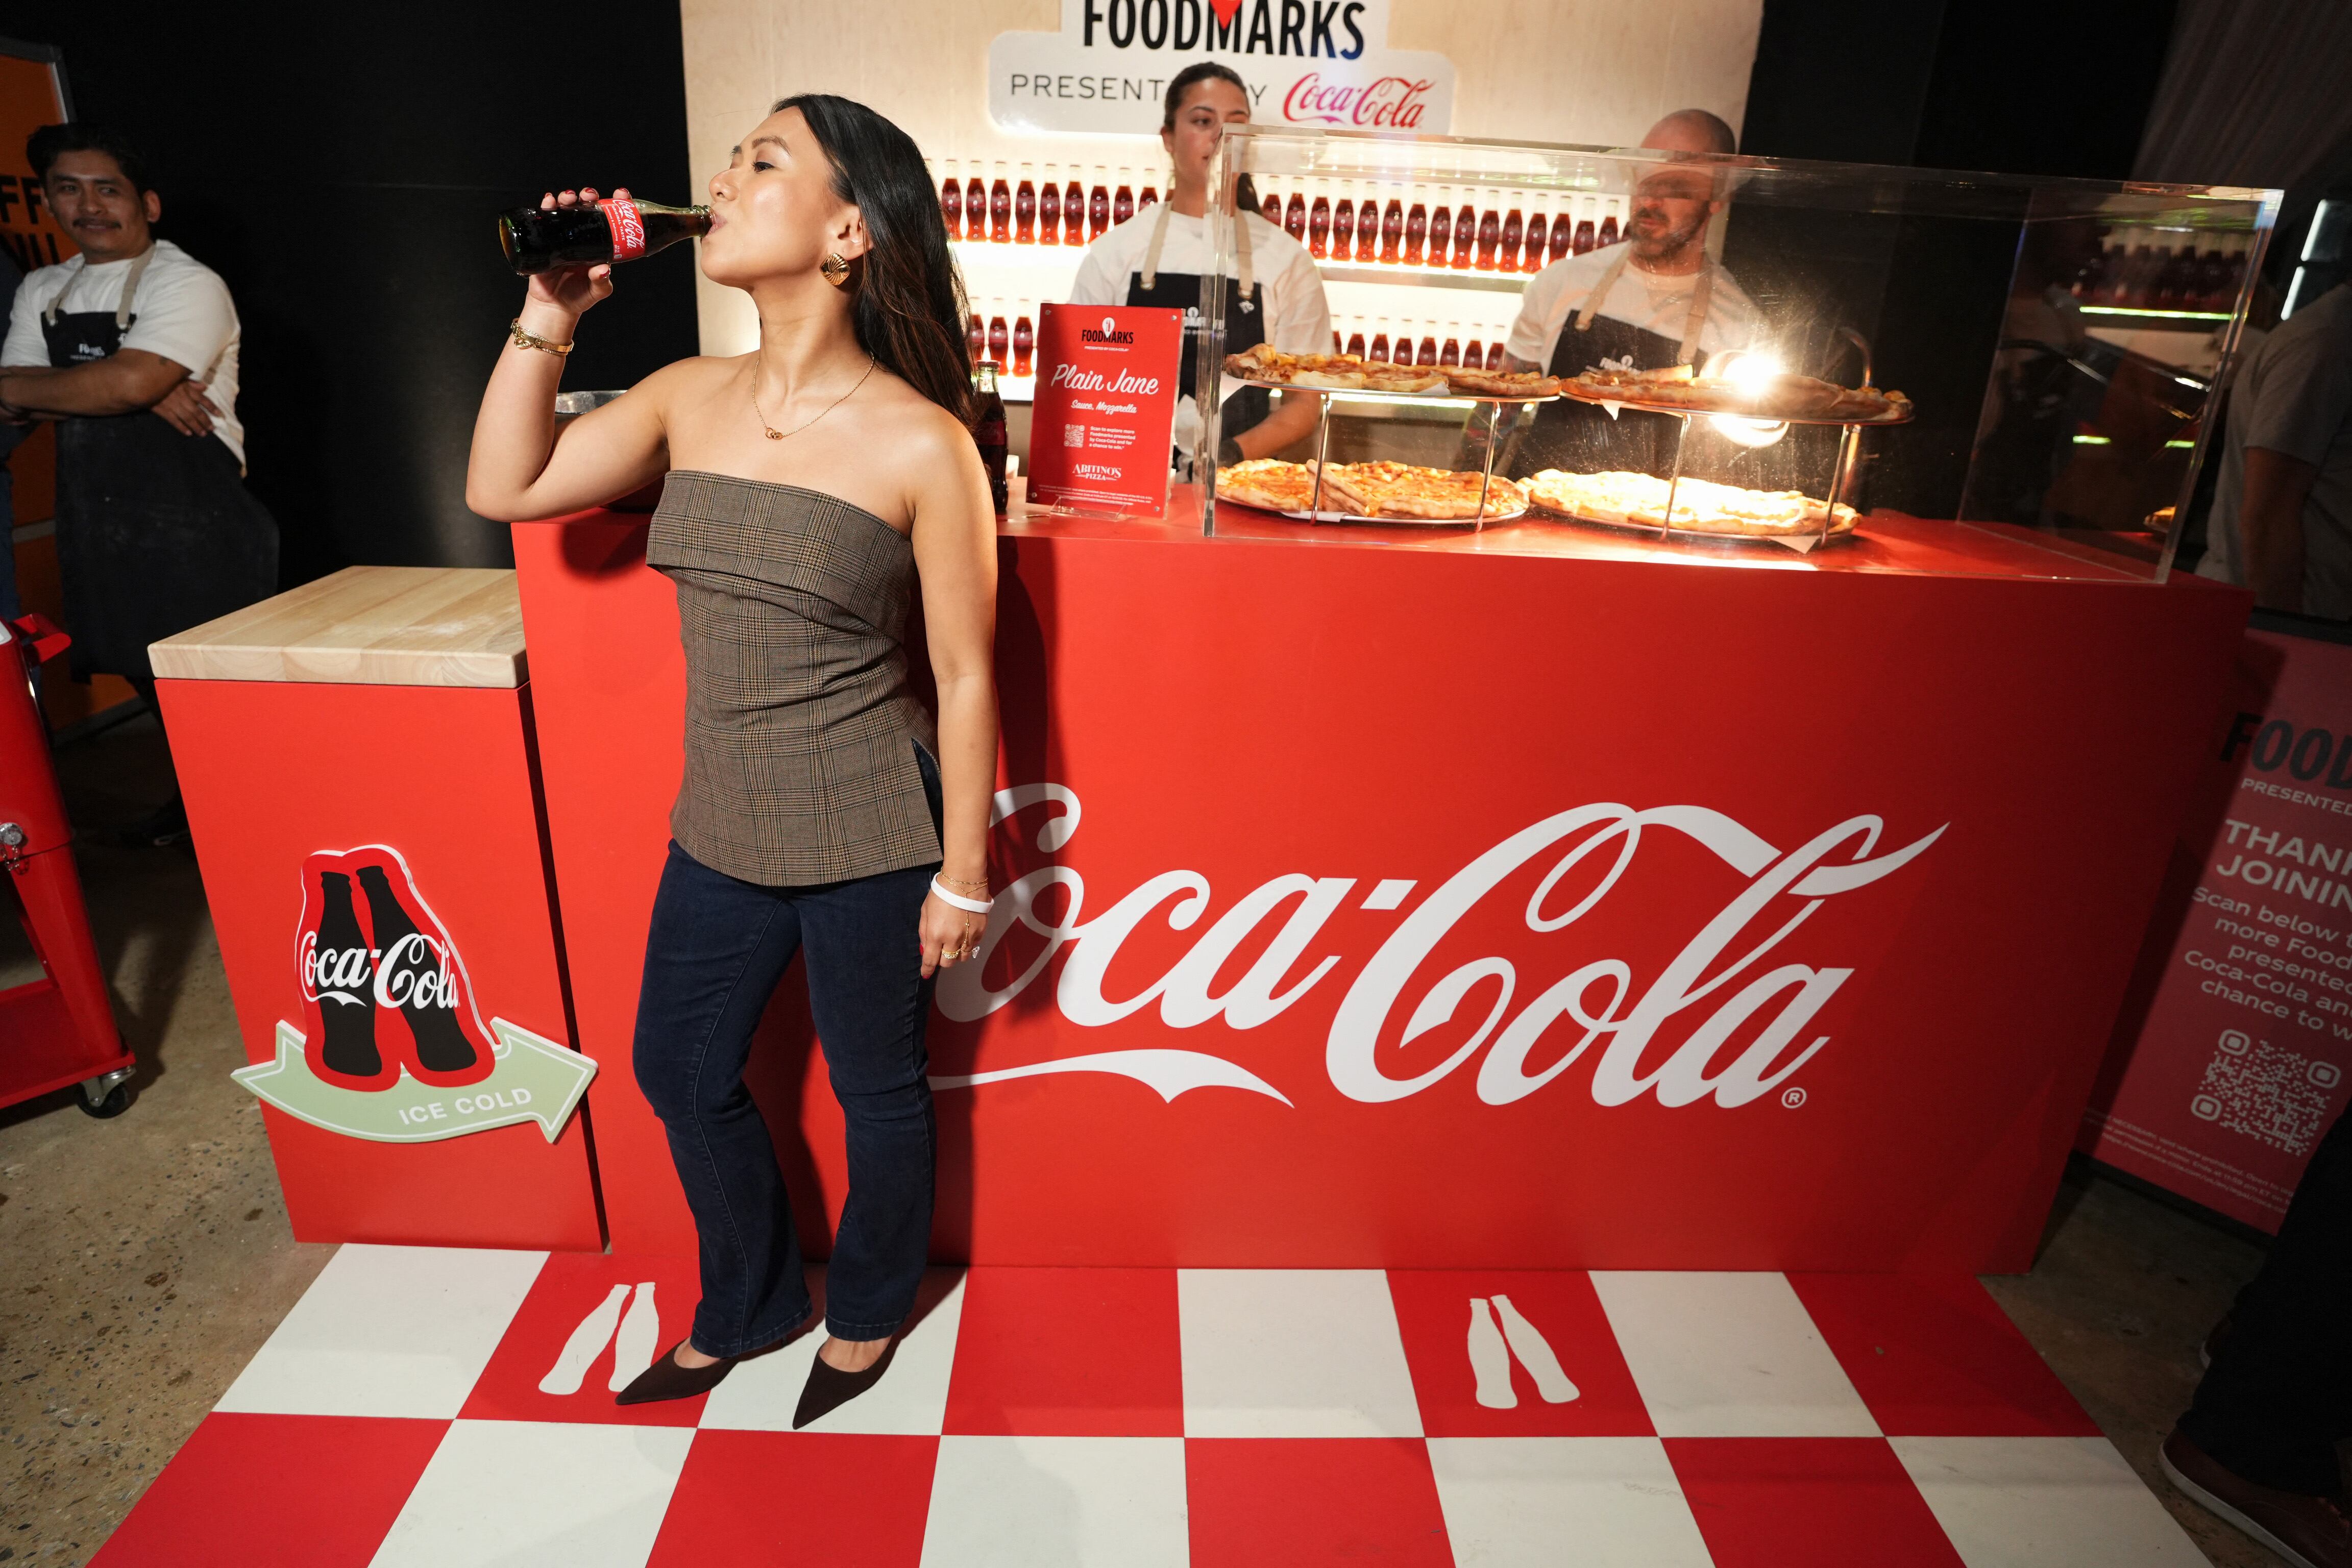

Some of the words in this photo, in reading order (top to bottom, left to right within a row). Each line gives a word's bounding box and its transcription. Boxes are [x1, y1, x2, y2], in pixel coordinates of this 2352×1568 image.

[1083, 0, 1366, 60] FOODMARKS
[1011, 74, 1164, 102] PRESENT
[1283, 72, 1436, 128] Coca-Cola
[612, 205, 621, 225] ORIGINAL
[612, 200, 644, 249] Coca-Cola
[1082, 329, 1134, 344] FOODMARKS
[1051, 364, 1104, 391] Plain
[1107, 368, 1159, 395] Jane
[1096, 402, 1137, 415] Mozzarella
[1072, 463, 1121, 479] ABITINO'S
[1085, 473, 1106, 481] PIZZA
[2193, 886, 2251, 916] Scan
[2257, 905, 2339, 942] below
[2215, 918, 2280, 947] more
[300, 931, 459, 1009] Coca-Cola
[2185, 950, 2309, 1003] Coca-Cola
[2201, 980, 2290, 1018] chance
[2298, 1010, 2324, 1030] to
[398, 1101, 448, 1125] ICE
[454, 1088, 532, 1116] COLD
